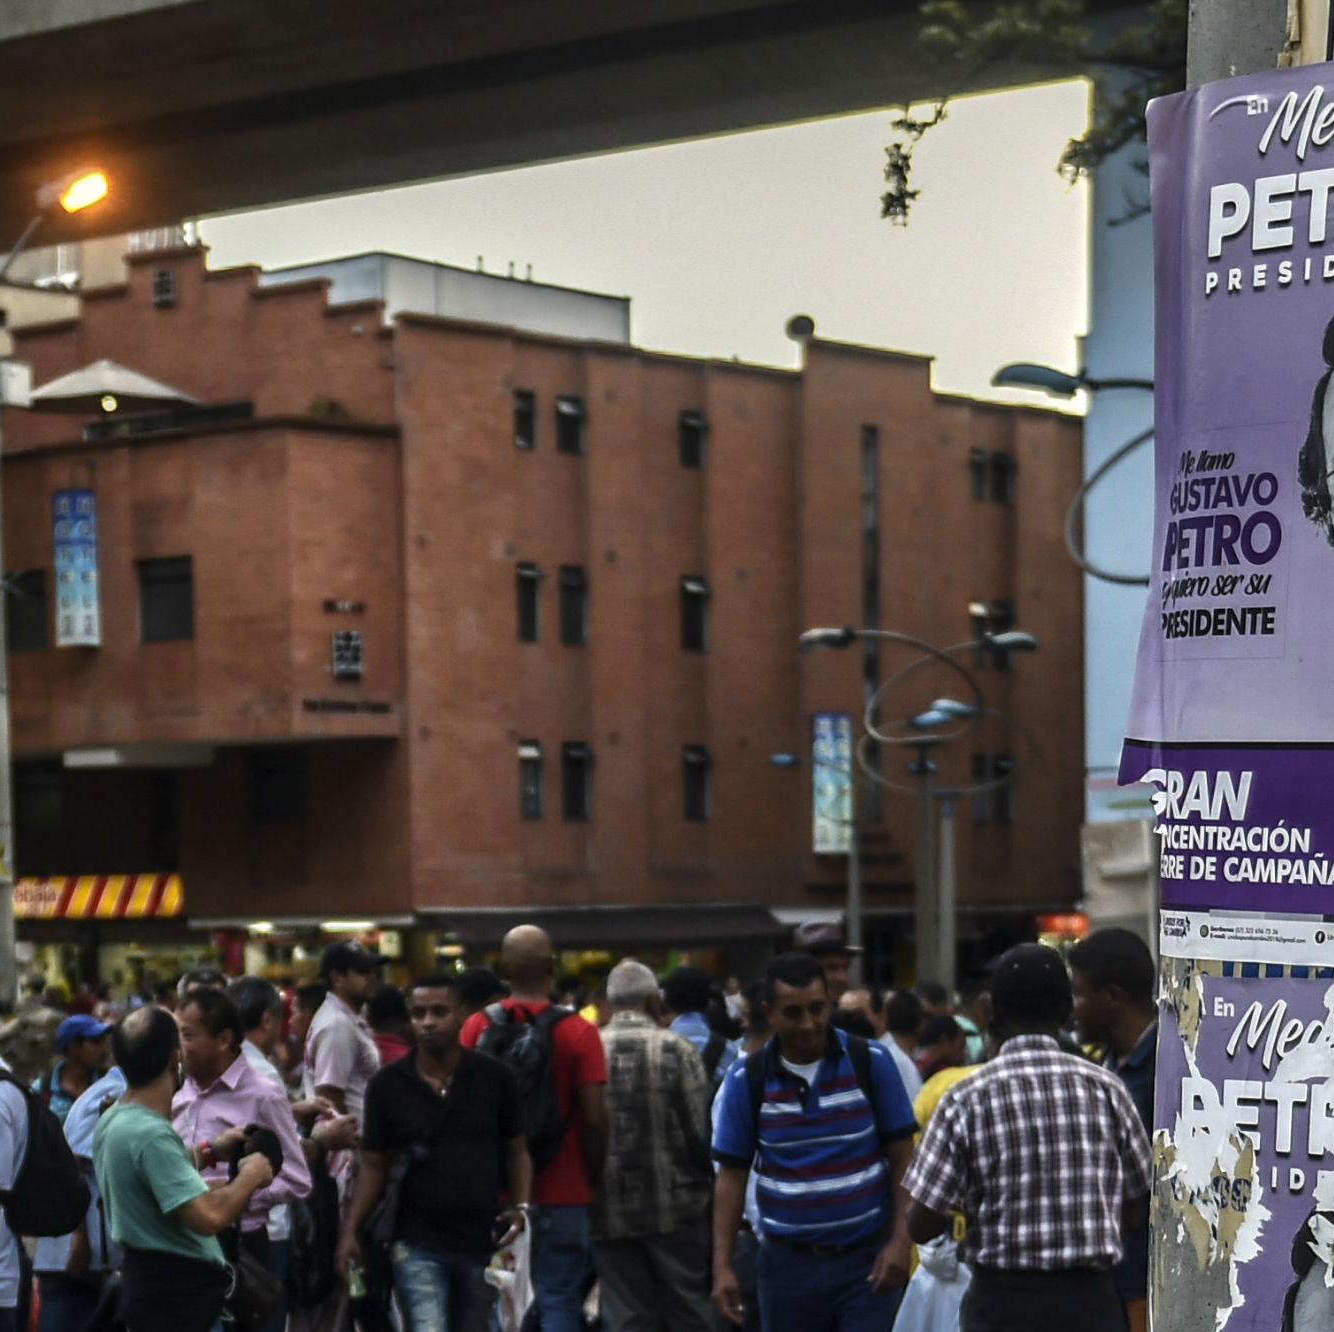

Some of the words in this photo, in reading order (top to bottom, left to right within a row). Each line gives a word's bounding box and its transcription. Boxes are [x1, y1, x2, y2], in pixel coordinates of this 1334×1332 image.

[1196, 450, 1235, 473] llamo
[1170, 472, 1278, 516] GUSTAVO
[1162, 511, 1282, 571] PETRO
[1211, 573, 1245, 597] ser
[1245, 573, 1272, 595] su
[1162, 606, 1276, 639] PRESIDENTE
[1140, 769, 1253, 821] GRAN
[1154, 819, 1311, 854] NCENTRACIÓN
[1161, 854, 1184, 880] ERRE
[1190, 855, 1217, 881] DE
[1214, 997, 1235, 1017] En
